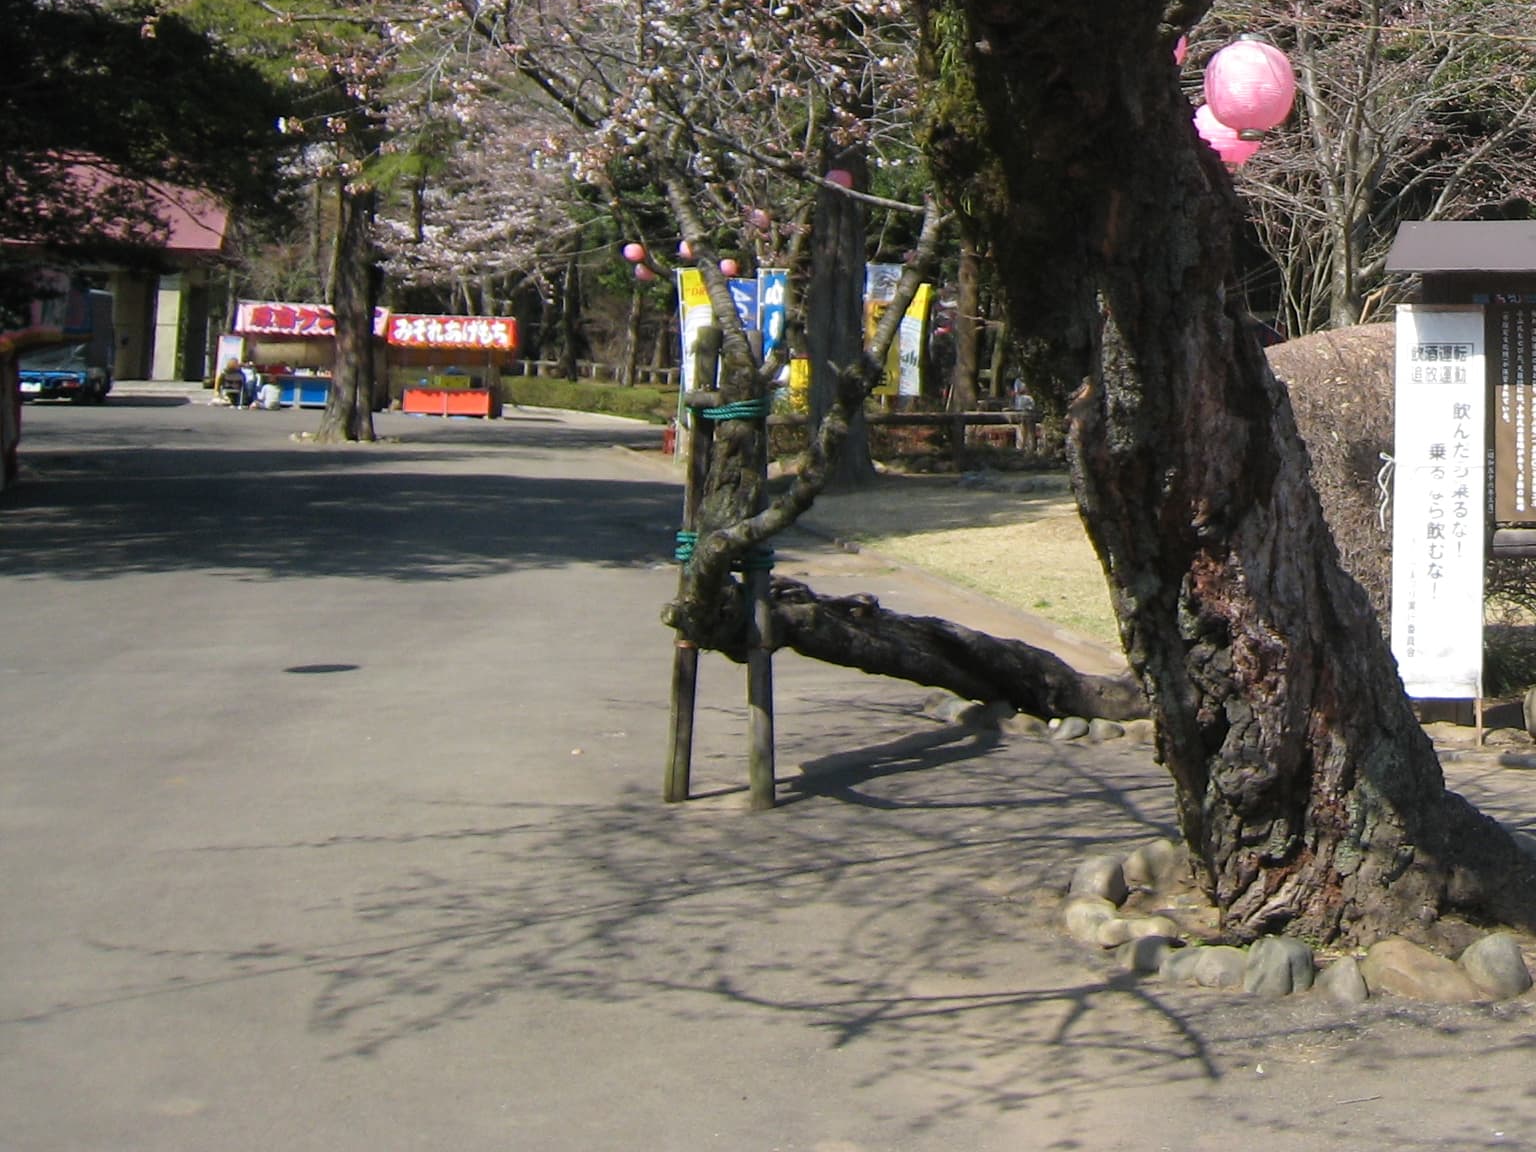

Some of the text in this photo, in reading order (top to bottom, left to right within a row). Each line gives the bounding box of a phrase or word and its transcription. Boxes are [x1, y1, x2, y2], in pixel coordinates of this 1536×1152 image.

[394, 319, 508, 345] みぞれあげもち
[1411, 345, 1467, 362] 飲酒運転
[1411, 366, 1467, 384] 追放運動
